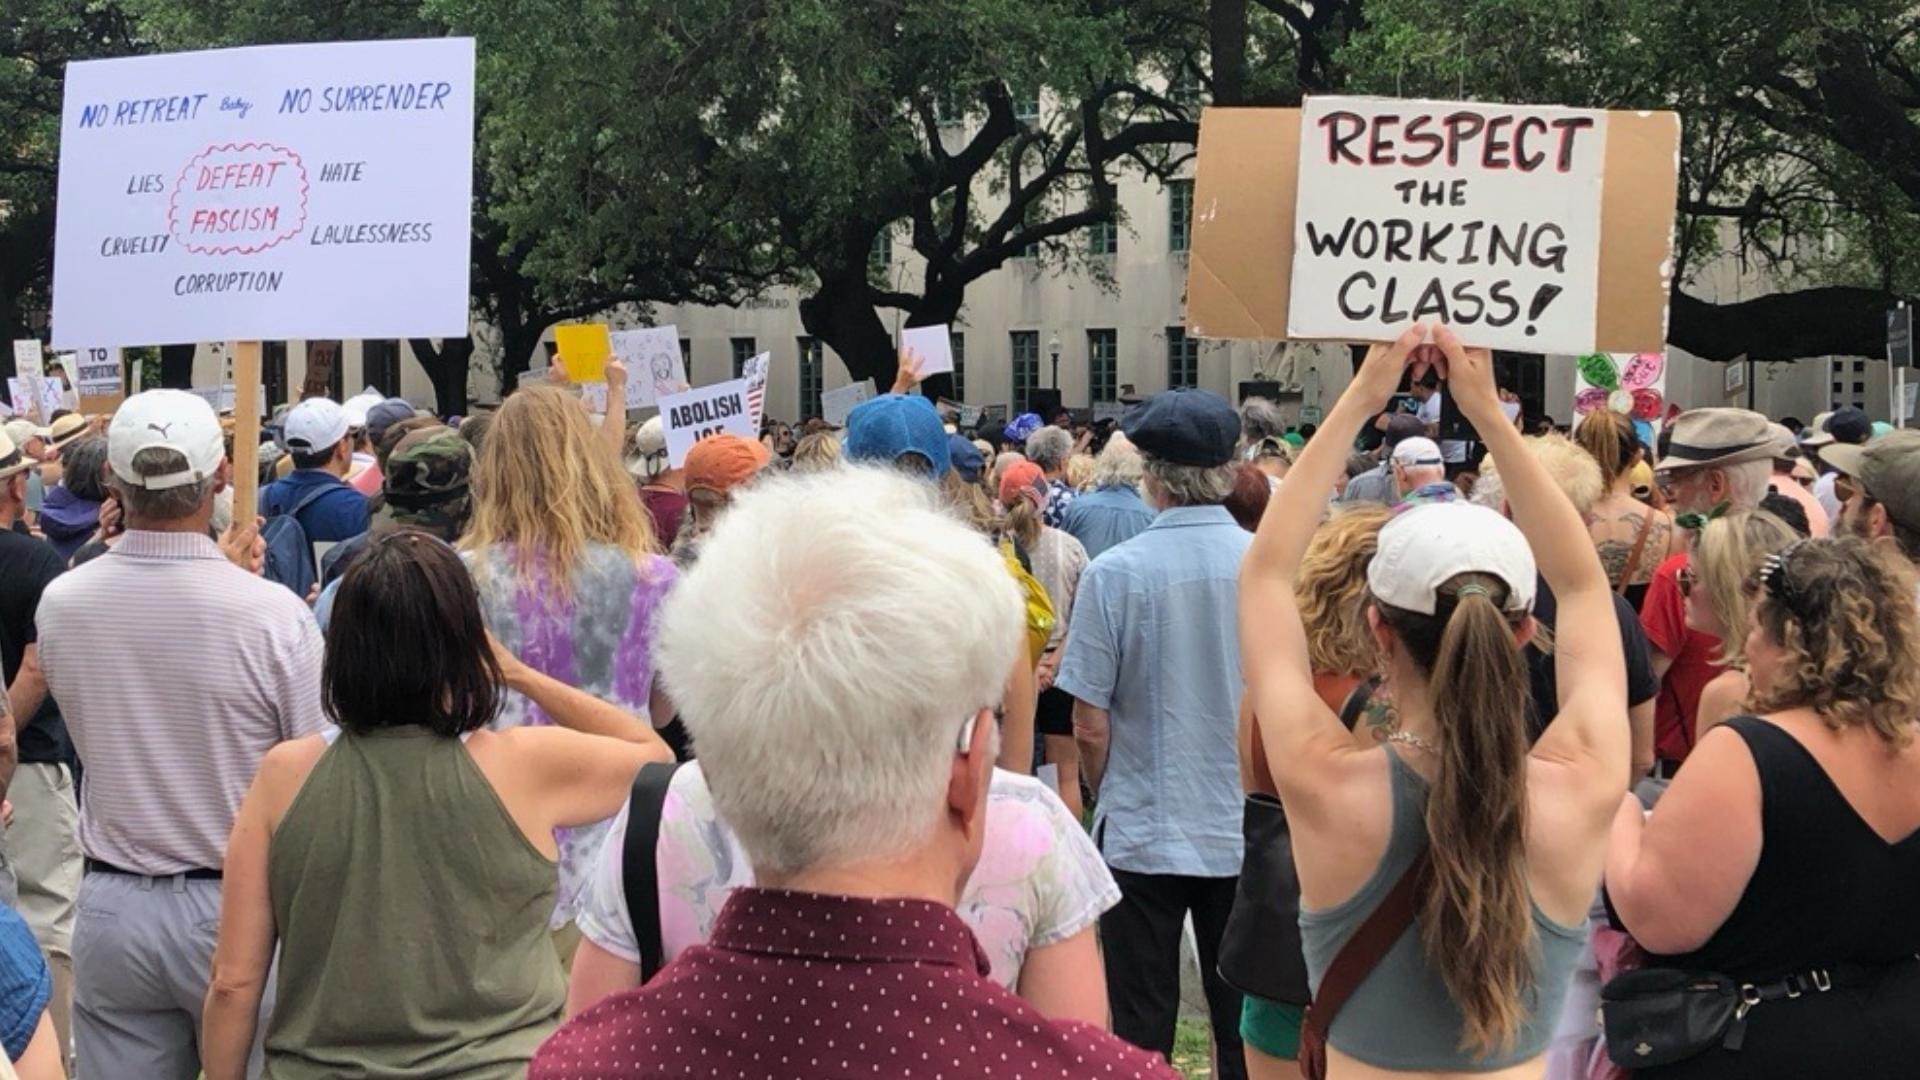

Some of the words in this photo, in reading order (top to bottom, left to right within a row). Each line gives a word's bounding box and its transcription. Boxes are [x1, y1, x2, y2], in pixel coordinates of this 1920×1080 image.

[79, 104, 108, 128] NO
[113, 94, 207, 126] RETREAT
[279, 88, 311, 114] NO
[319, 82, 451, 112] SURRENDER
[1318, 111, 1594, 172] RESPECT
[127, 174, 164, 195] LIES
[197, 161, 286, 191] DEFEAT
[320, 161, 367, 182] HATE
[1394, 179, 1468, 206] THE
[190, 206, 279, 234] FASCISM
[101, 234, 169, 257] CRUELTY
[310, 222, 433, 246] LAWLESSNESS
[1306, 217, 1568, 273] WORKING
[174, 270, 283, 297] CORRUPTION
[1337, 271, 1564, 337] CLASS!
[88, 348, 108, 361] TO
[670, 393, 742, 430] ABOLISH
